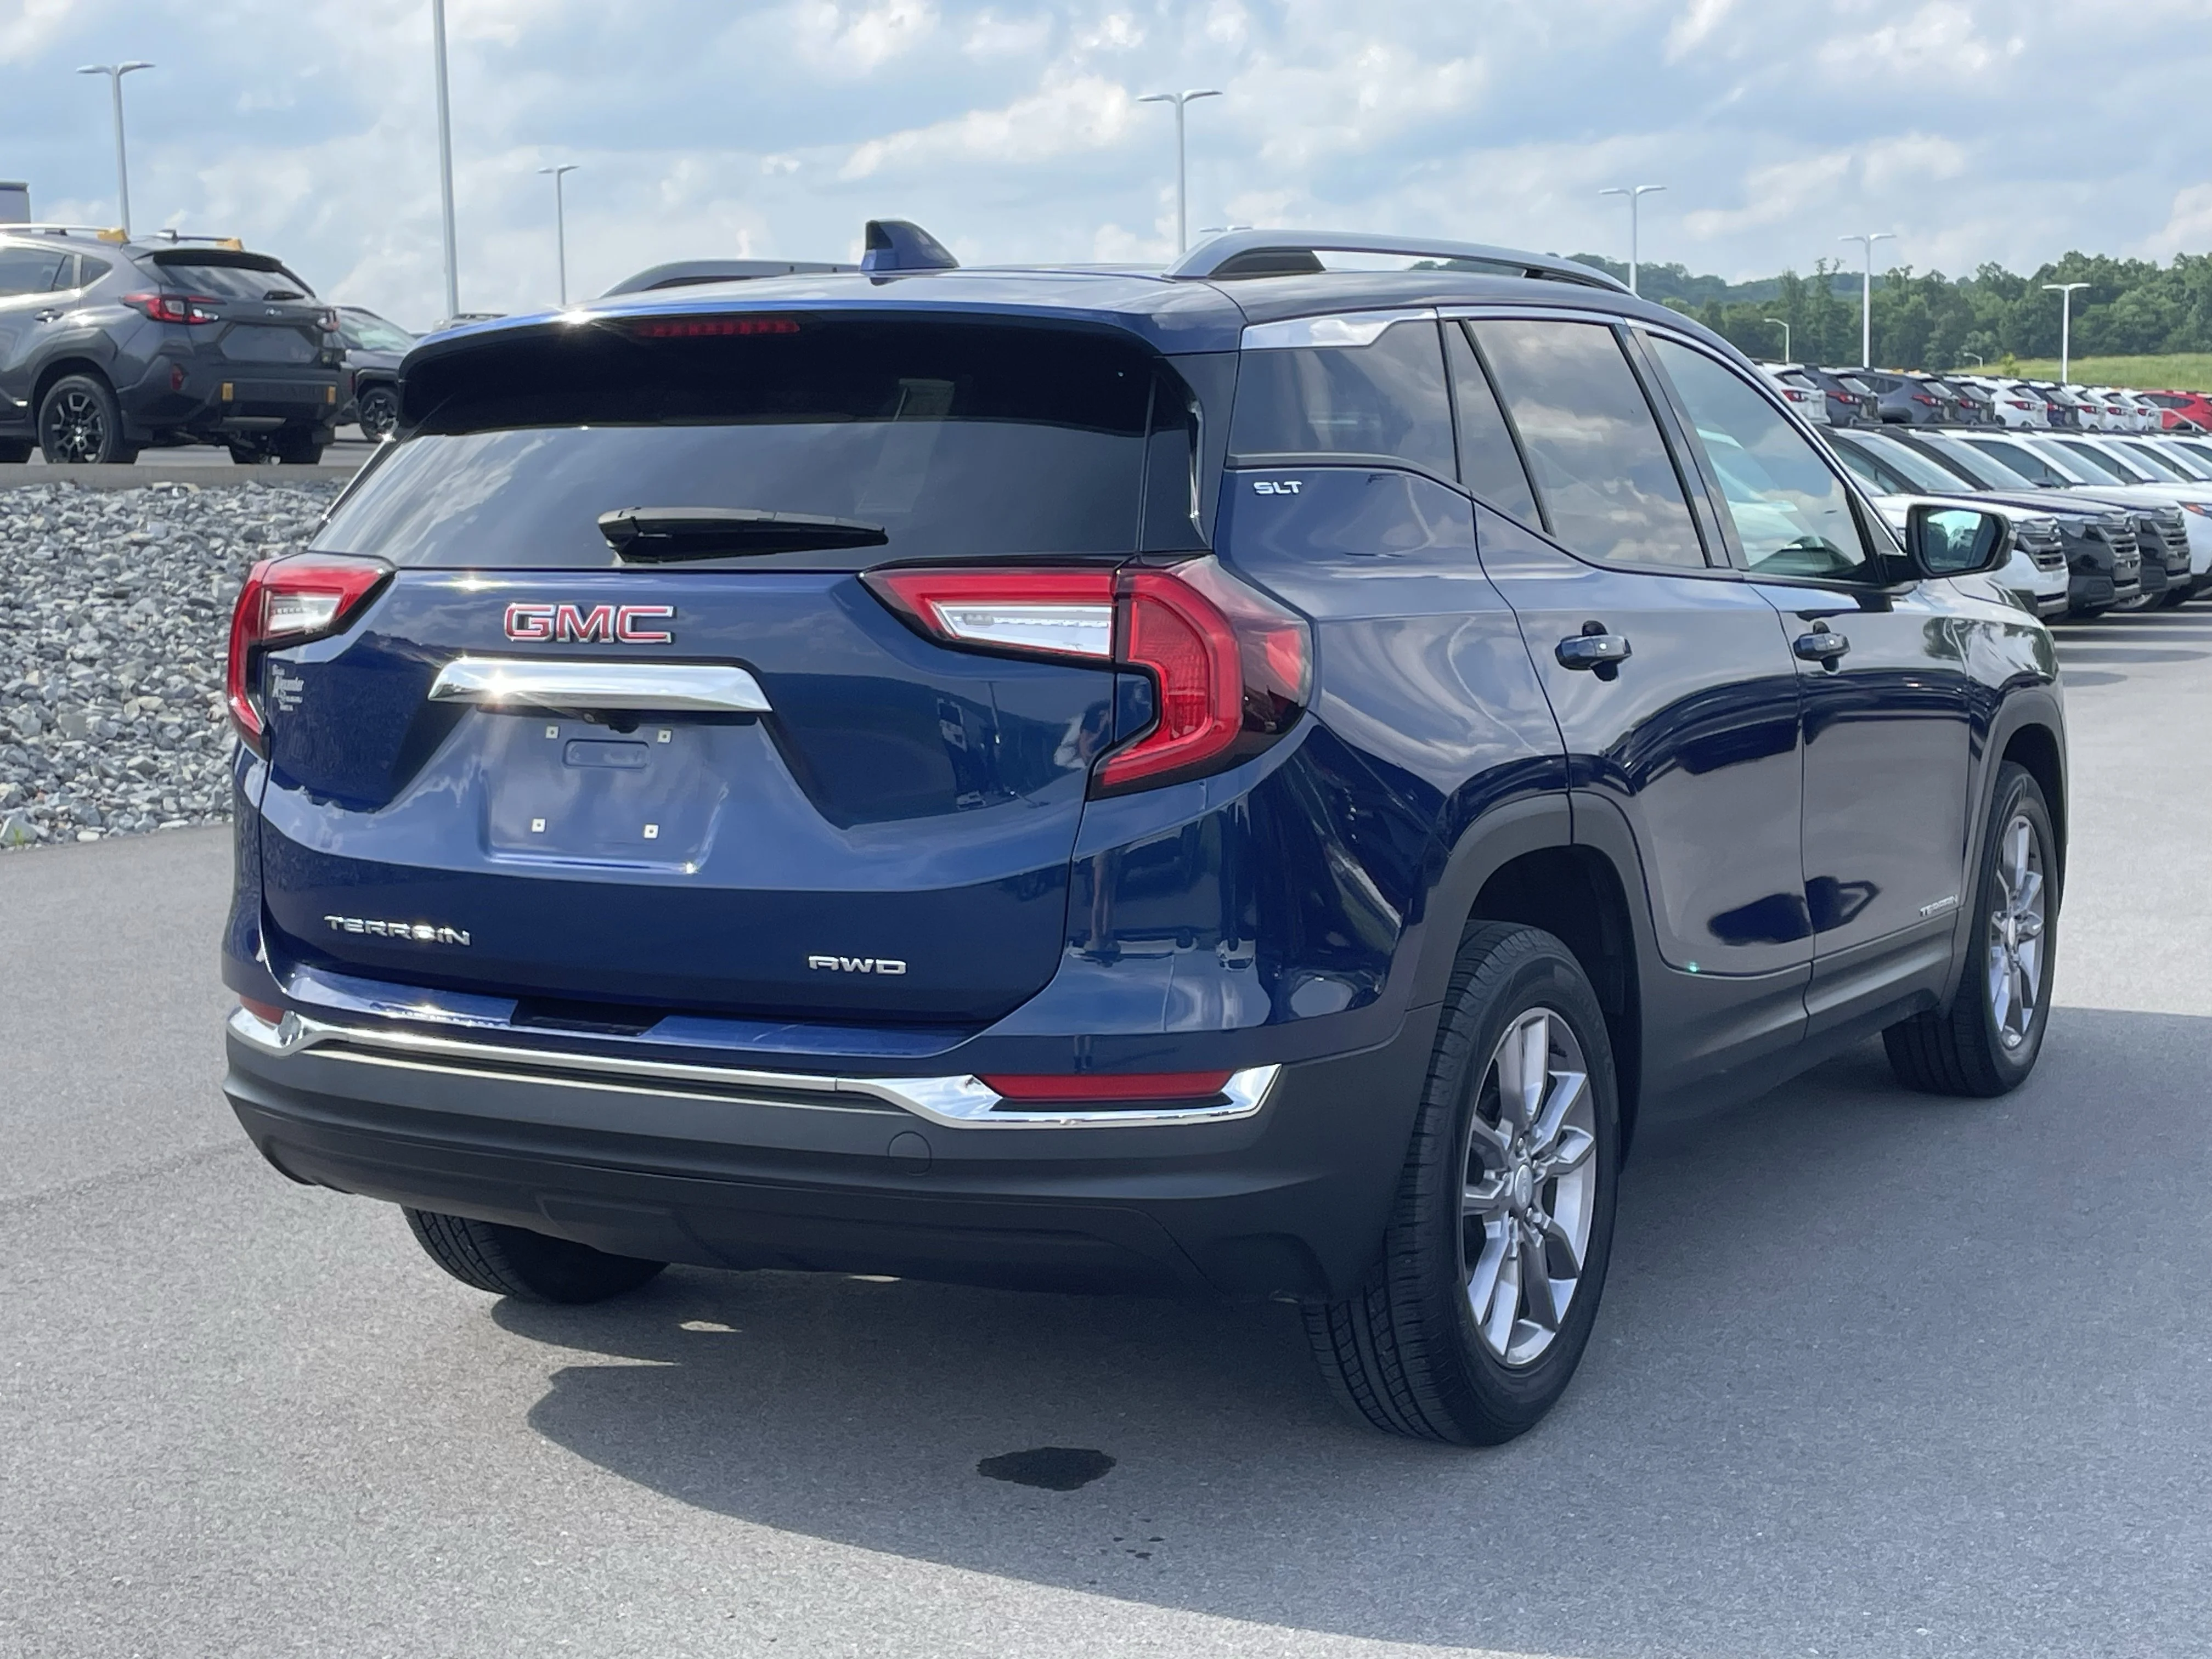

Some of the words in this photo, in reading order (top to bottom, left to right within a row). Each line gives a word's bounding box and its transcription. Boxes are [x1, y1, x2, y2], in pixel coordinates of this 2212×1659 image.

[1254, 481, 1302, 494] SLT
[504, 602, 674, 644] GMC
[324, 915, 470, 946] TERRAIN
[809, 955, 906, 975] AWD
